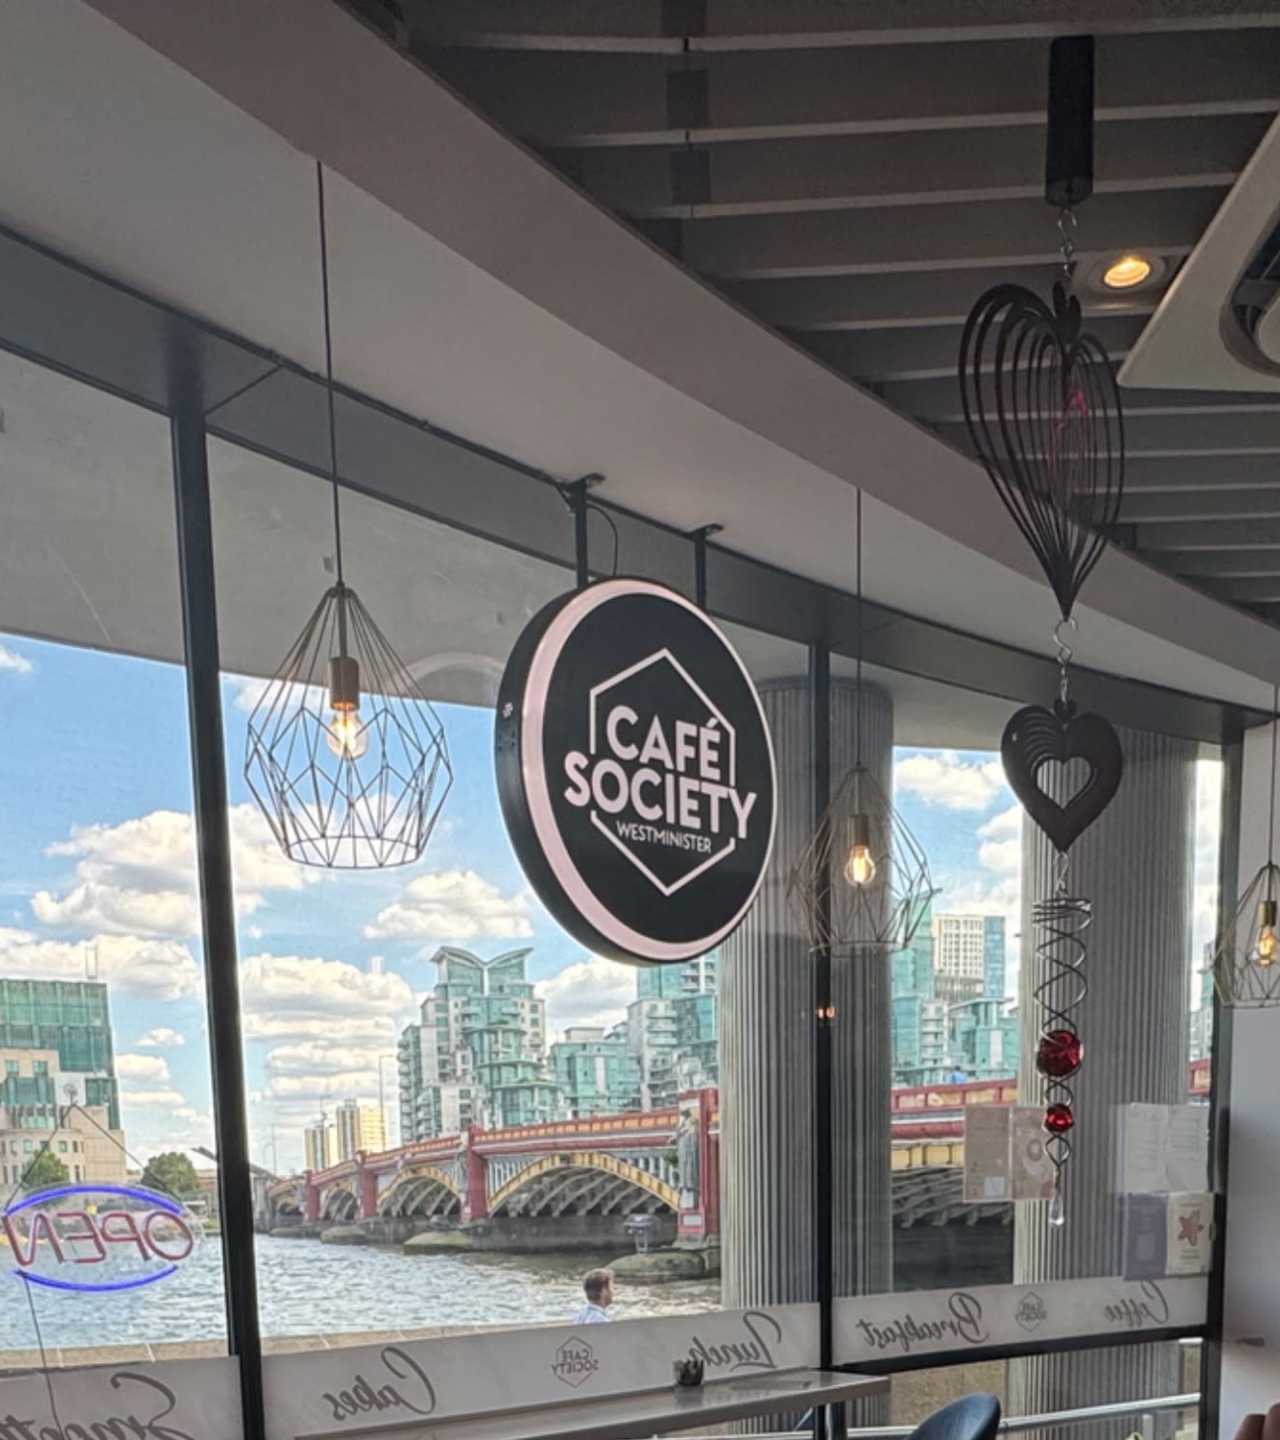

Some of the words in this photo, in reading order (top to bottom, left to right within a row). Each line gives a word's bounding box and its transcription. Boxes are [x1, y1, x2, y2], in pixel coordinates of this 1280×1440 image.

[606, 704, 722, 782] CAFÉ
[564, 751, 757, 839] SOCIETY
[616, 820, 713, 854] WESTMINISTER
